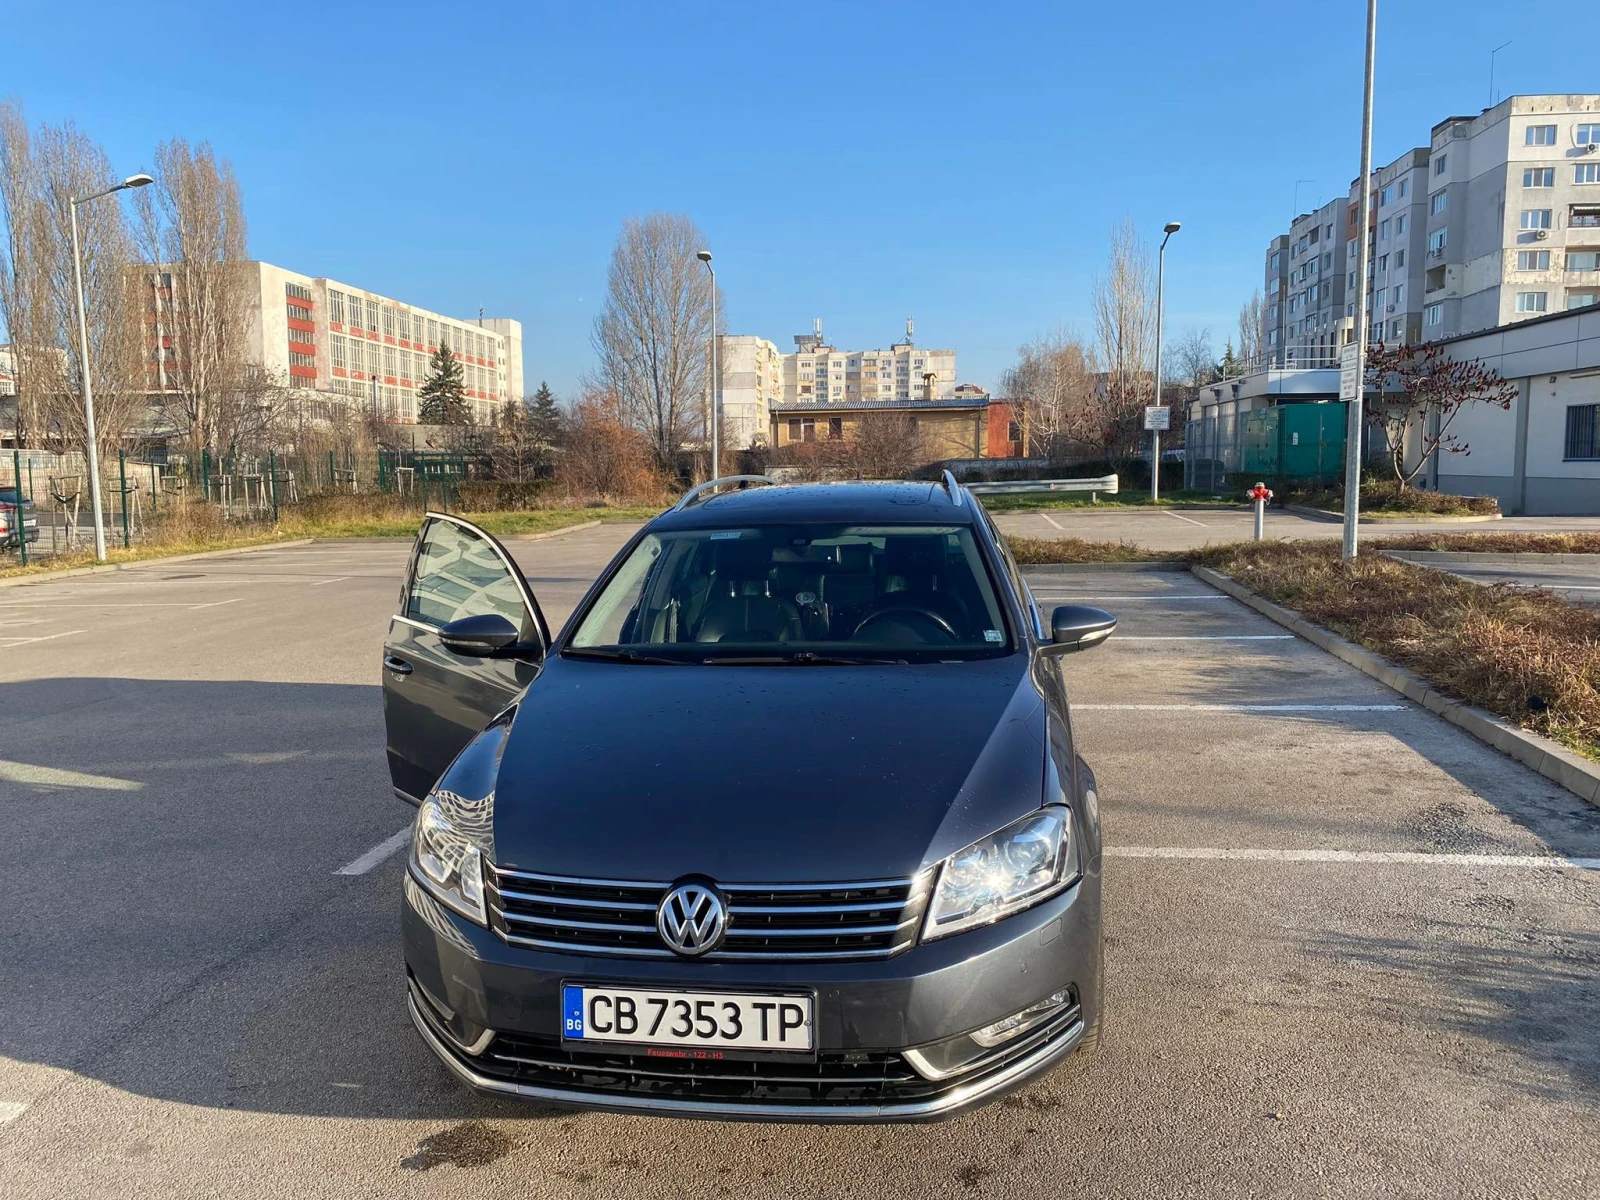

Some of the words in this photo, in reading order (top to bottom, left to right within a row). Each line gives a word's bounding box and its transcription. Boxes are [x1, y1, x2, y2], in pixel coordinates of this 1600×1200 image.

[660, 885, 722, 953] VW
[566, 1018, 582, 1031] BG
[589, 995, 639, 1035] CB
[646, 998, 743, 1040] 7353
[751, 1003, 804, 1042] TP
[647, 1048, 687, 1058] Feuerwehr
[693, 1051, 707, 1059] 122
[712, 1052, 724, 1060] H3
